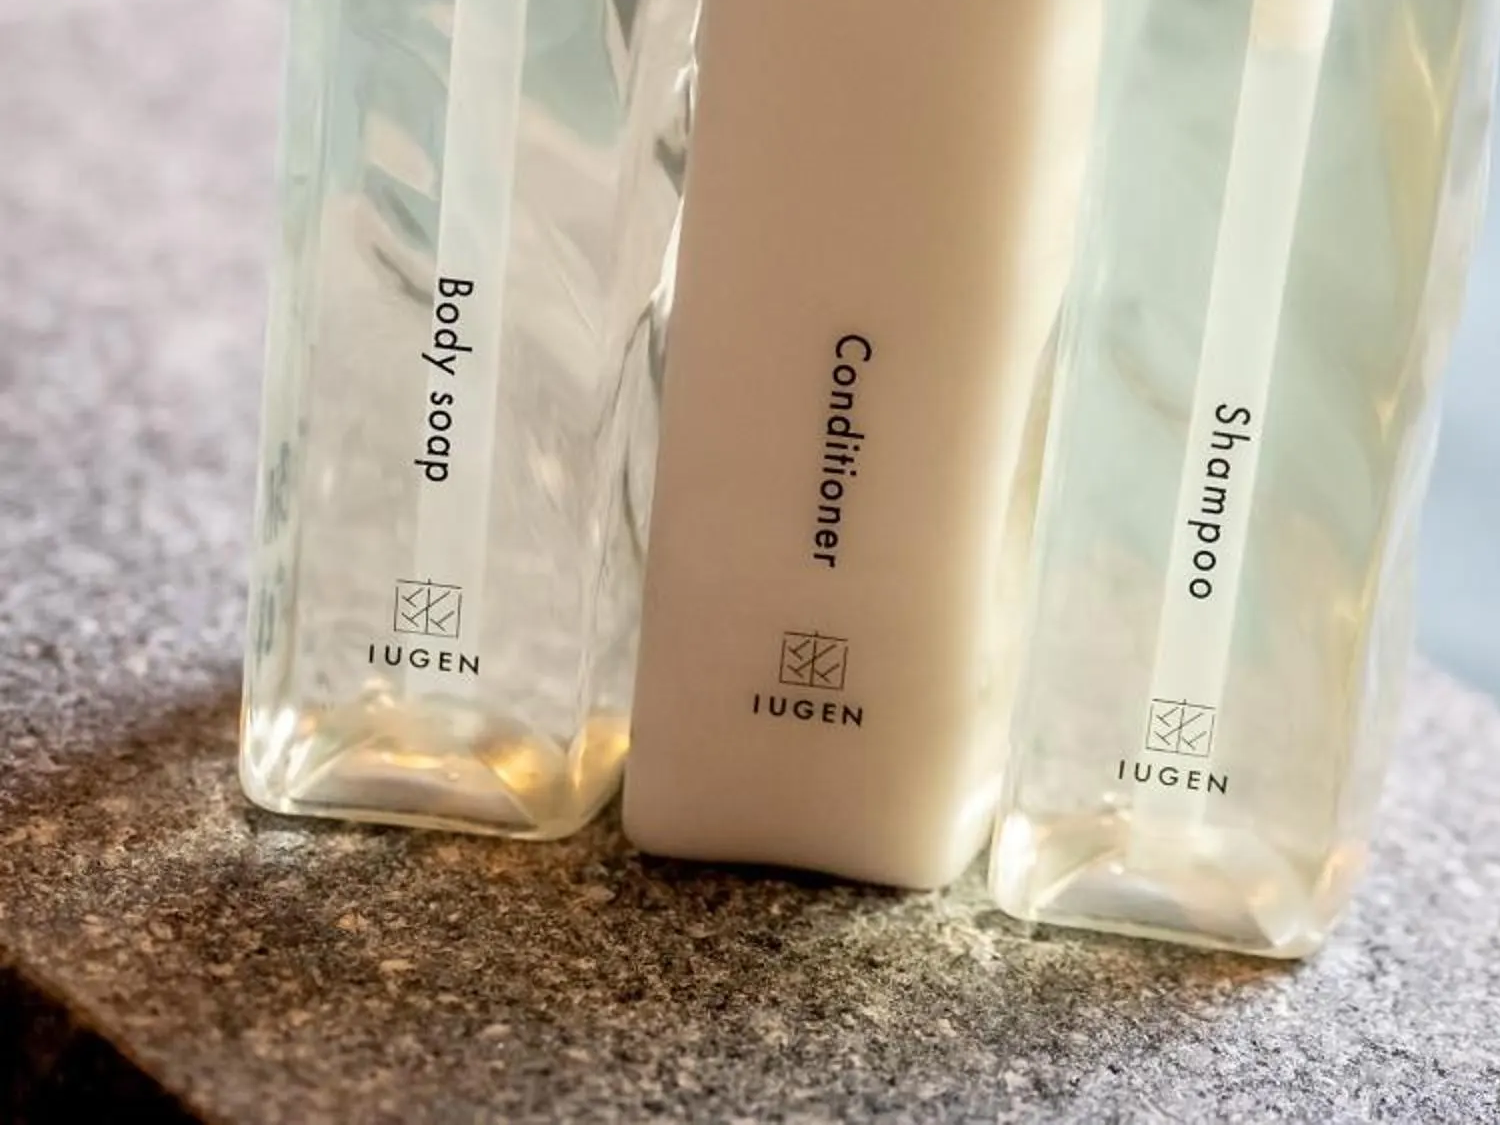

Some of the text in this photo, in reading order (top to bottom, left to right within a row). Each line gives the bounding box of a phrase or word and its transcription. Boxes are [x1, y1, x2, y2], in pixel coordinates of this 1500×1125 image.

[414, 277, 474, 482] Body soap
[814, 334, 872, 568] Conditioner
[1188, 404, 1251, 599] Shampoo
[368, 644, 480, 675] IUGEN
[752, 694, 863, 727] IUGEN
[1117, 760, 1229, 794] IUGEN
